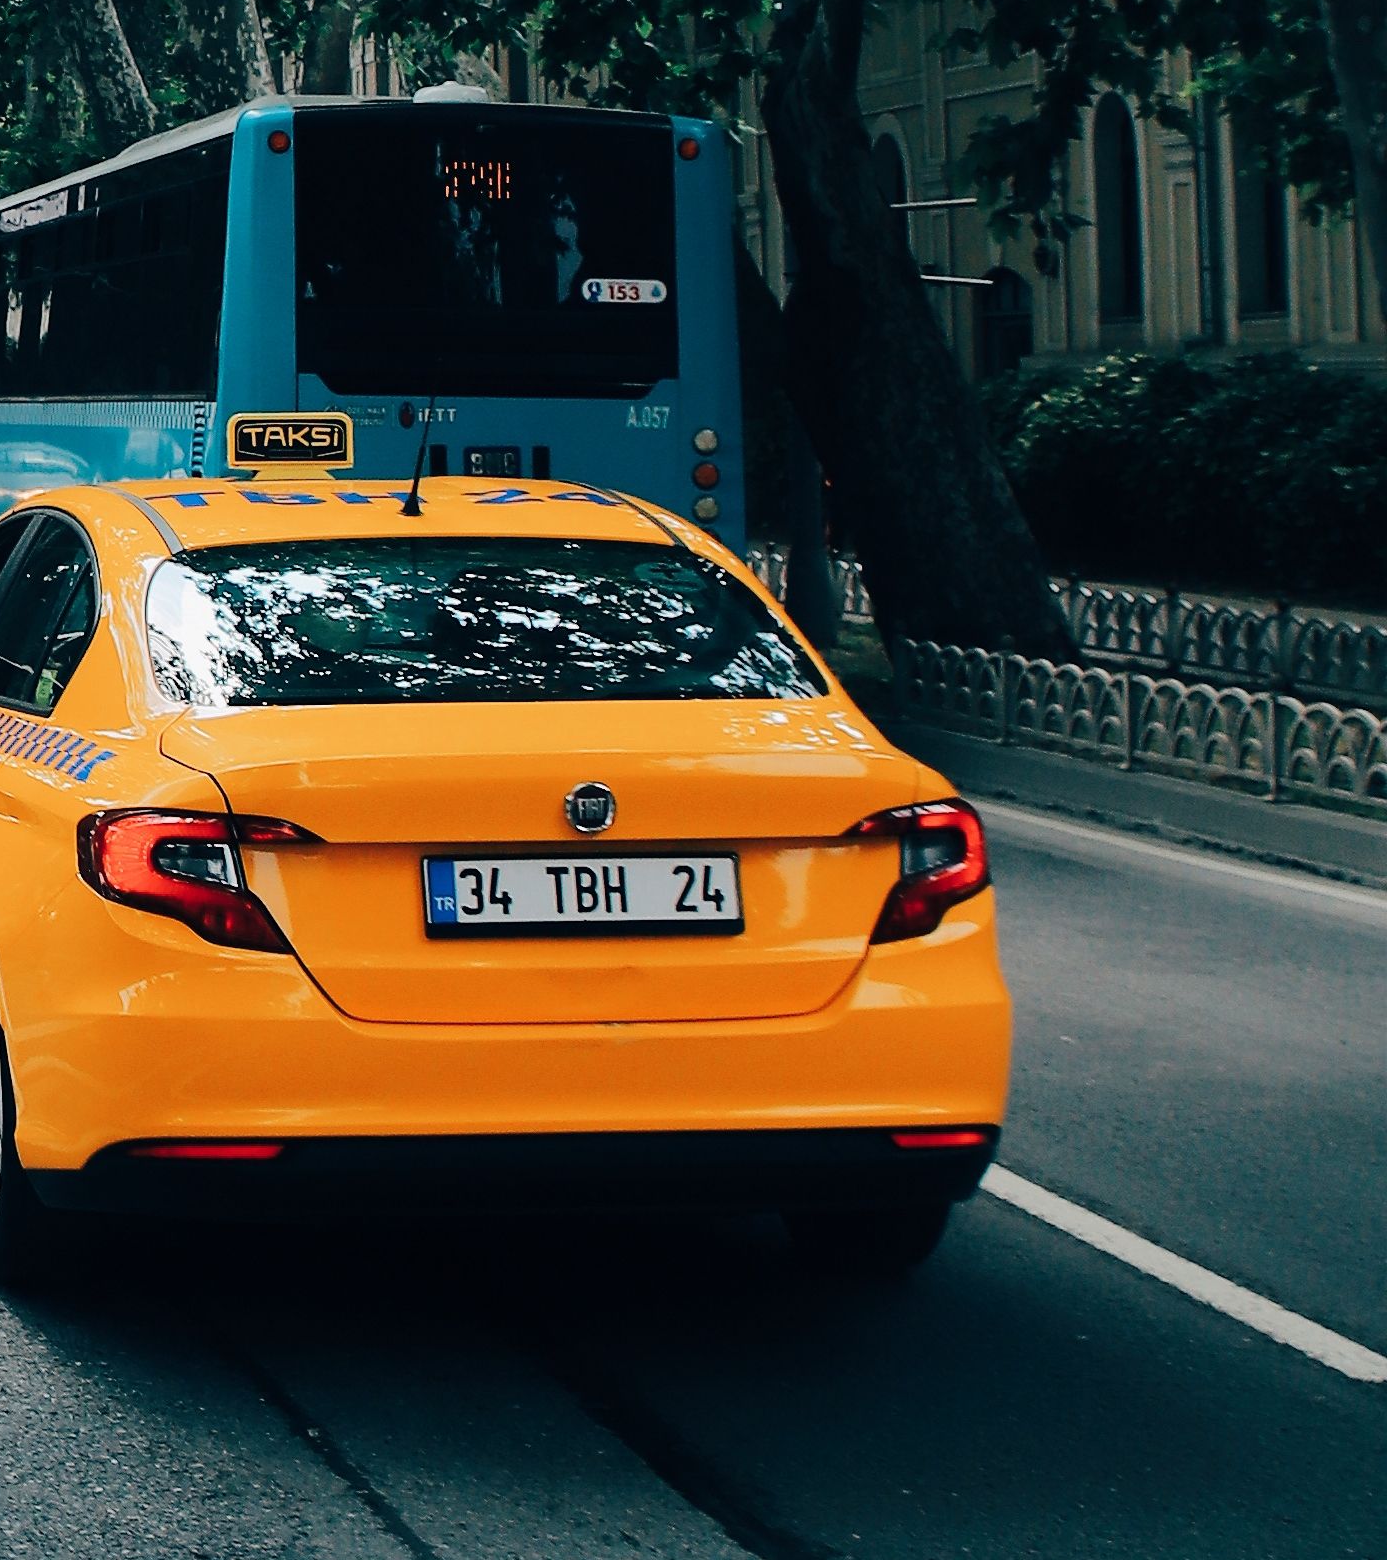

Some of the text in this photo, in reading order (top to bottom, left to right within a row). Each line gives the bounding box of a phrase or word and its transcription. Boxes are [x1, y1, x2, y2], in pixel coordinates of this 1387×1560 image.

[608, 284, 640, 301] 153
[627, 406, 670, 429] A.057
[577, 797, 607, 820] FIAT
[434, 864, 726, 916] TR 34 TBH 24
